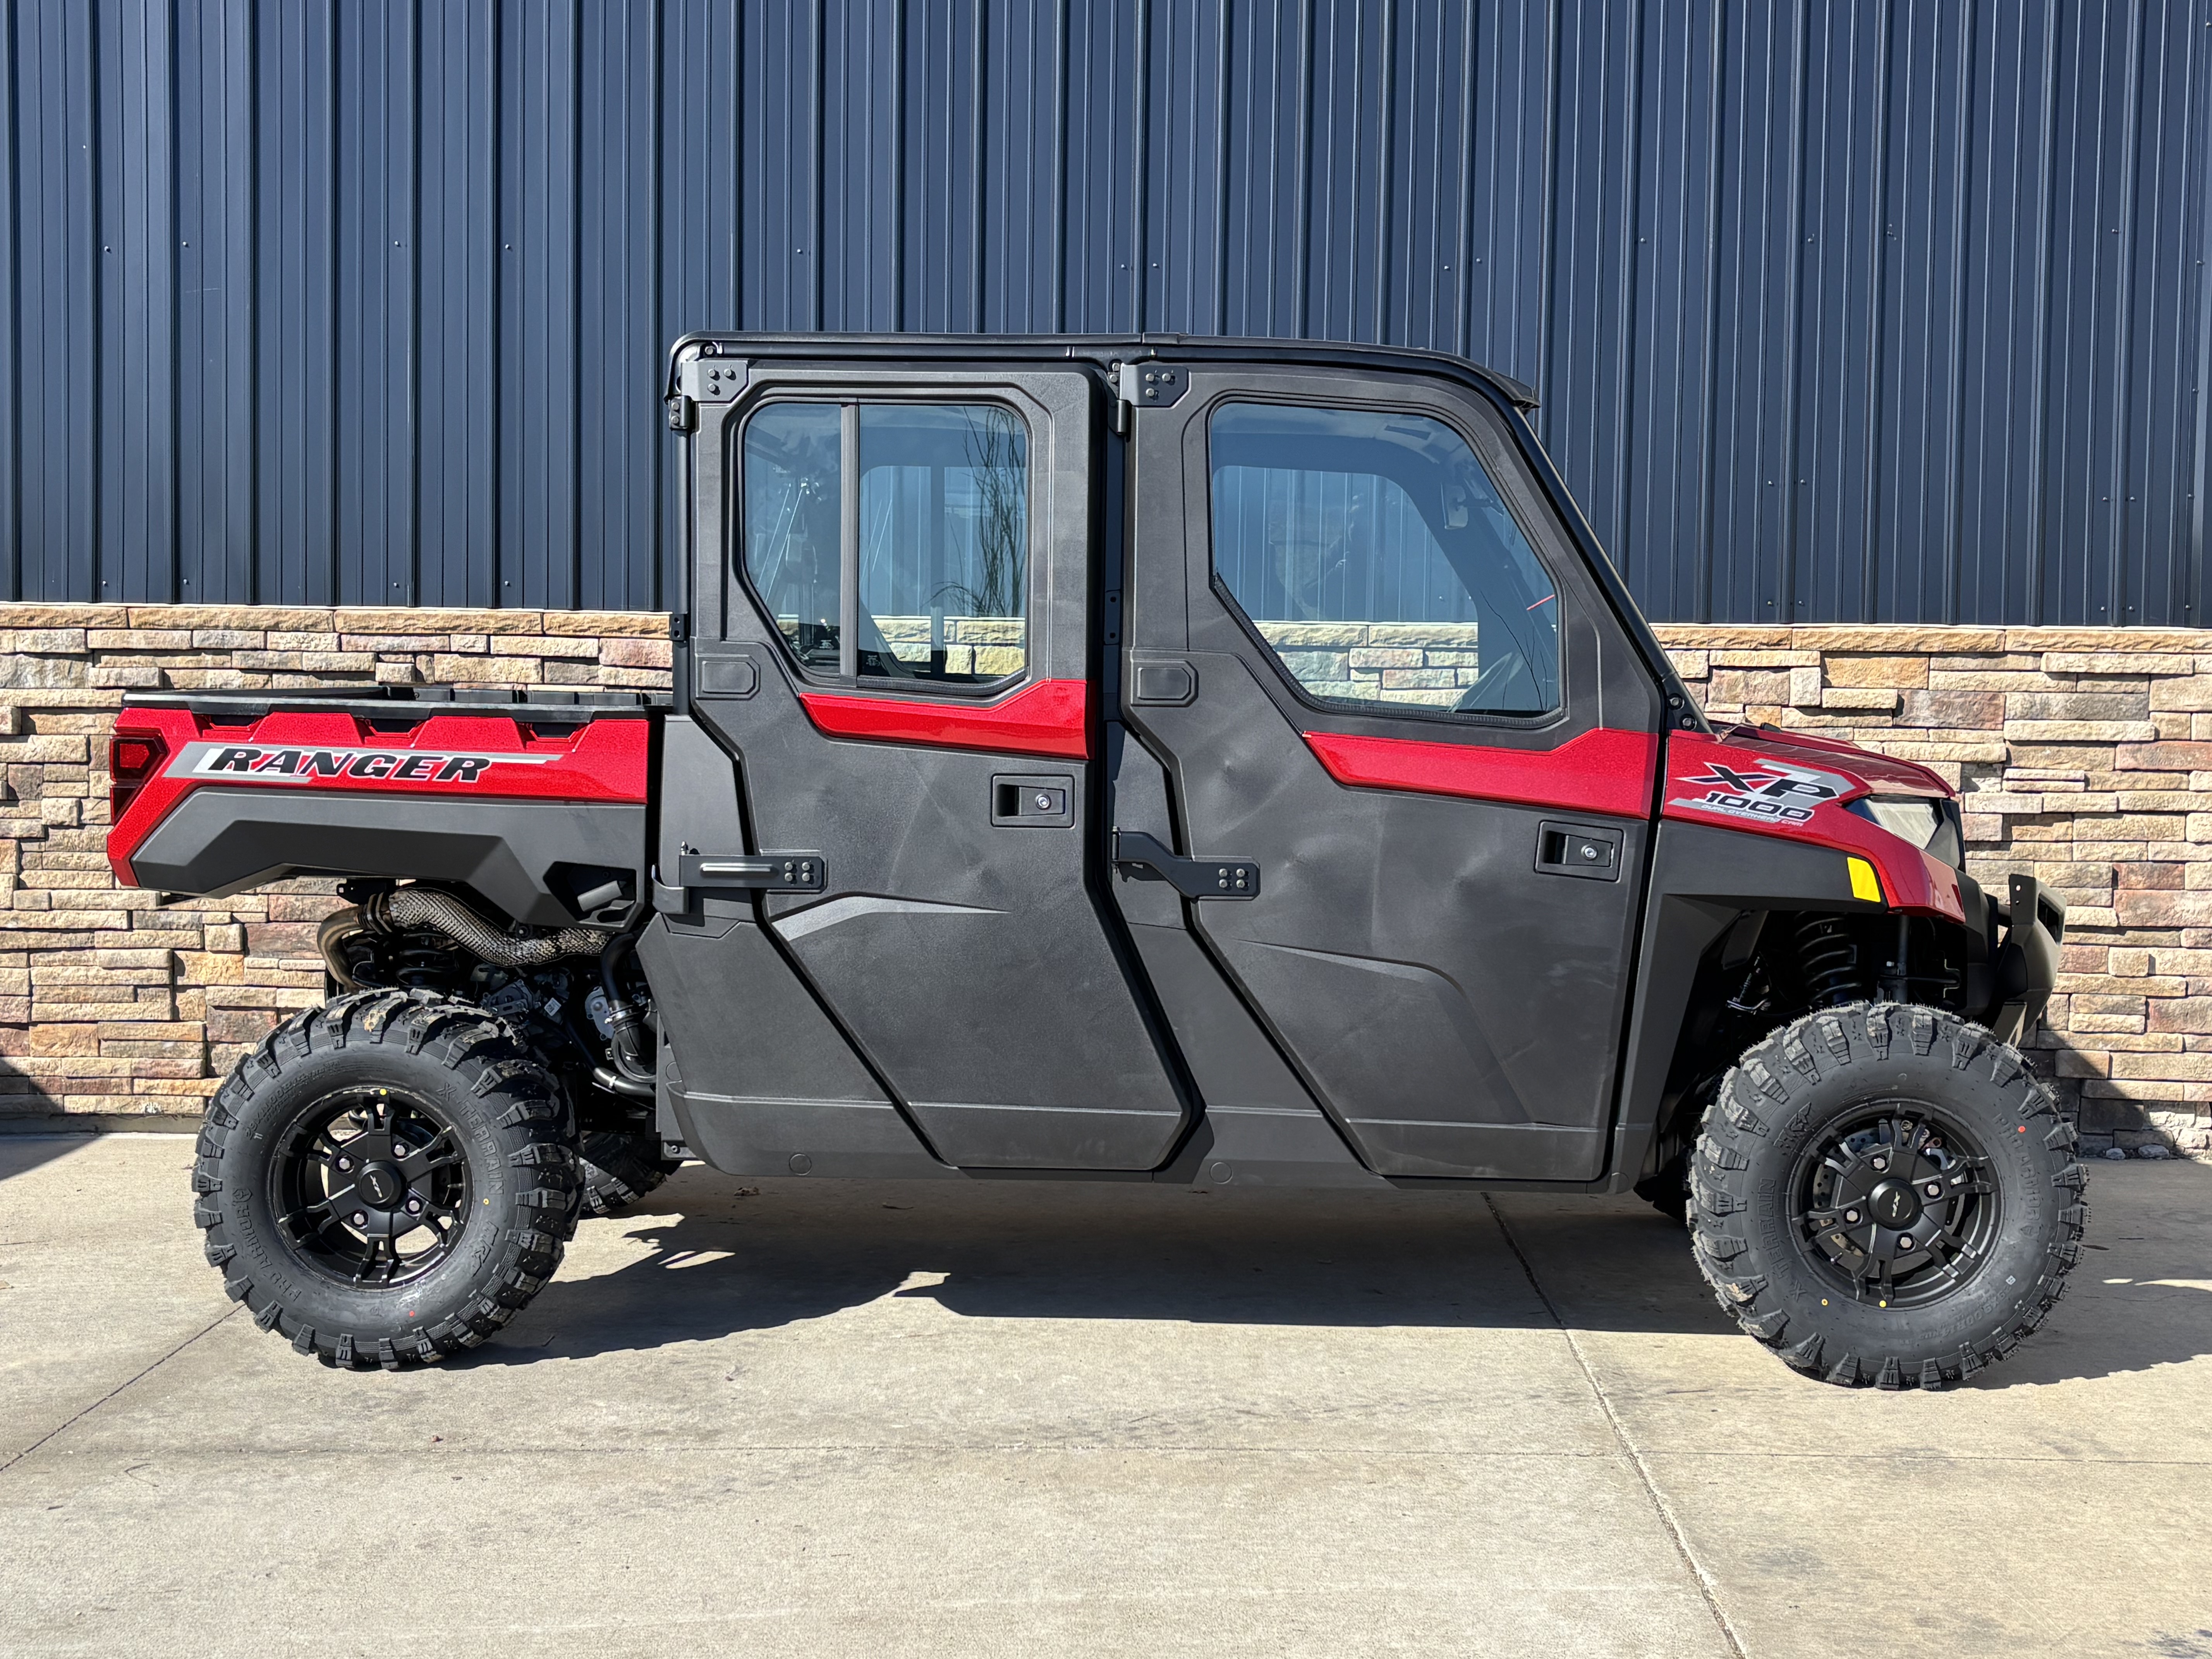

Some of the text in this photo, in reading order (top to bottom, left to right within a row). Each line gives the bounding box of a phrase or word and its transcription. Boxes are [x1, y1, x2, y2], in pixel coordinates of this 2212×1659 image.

[208, 747, 491, 782] RANGER
[1676, 762, 1839, 799] XP
[1701, 804, 1726, 813] DUAL
[1728, 809, 1781, 822] OVERHEAD
[1705, 791, 1814, 822] 1000
[458, 1100, 504, 1195] TERRAIN
[1993, 1113, 2042, 1221] PRO ARMOR
[236, 1204, 302, 1302] PRO ARMOR
[1758, 1177, 1789, 1279] TERRAIN
